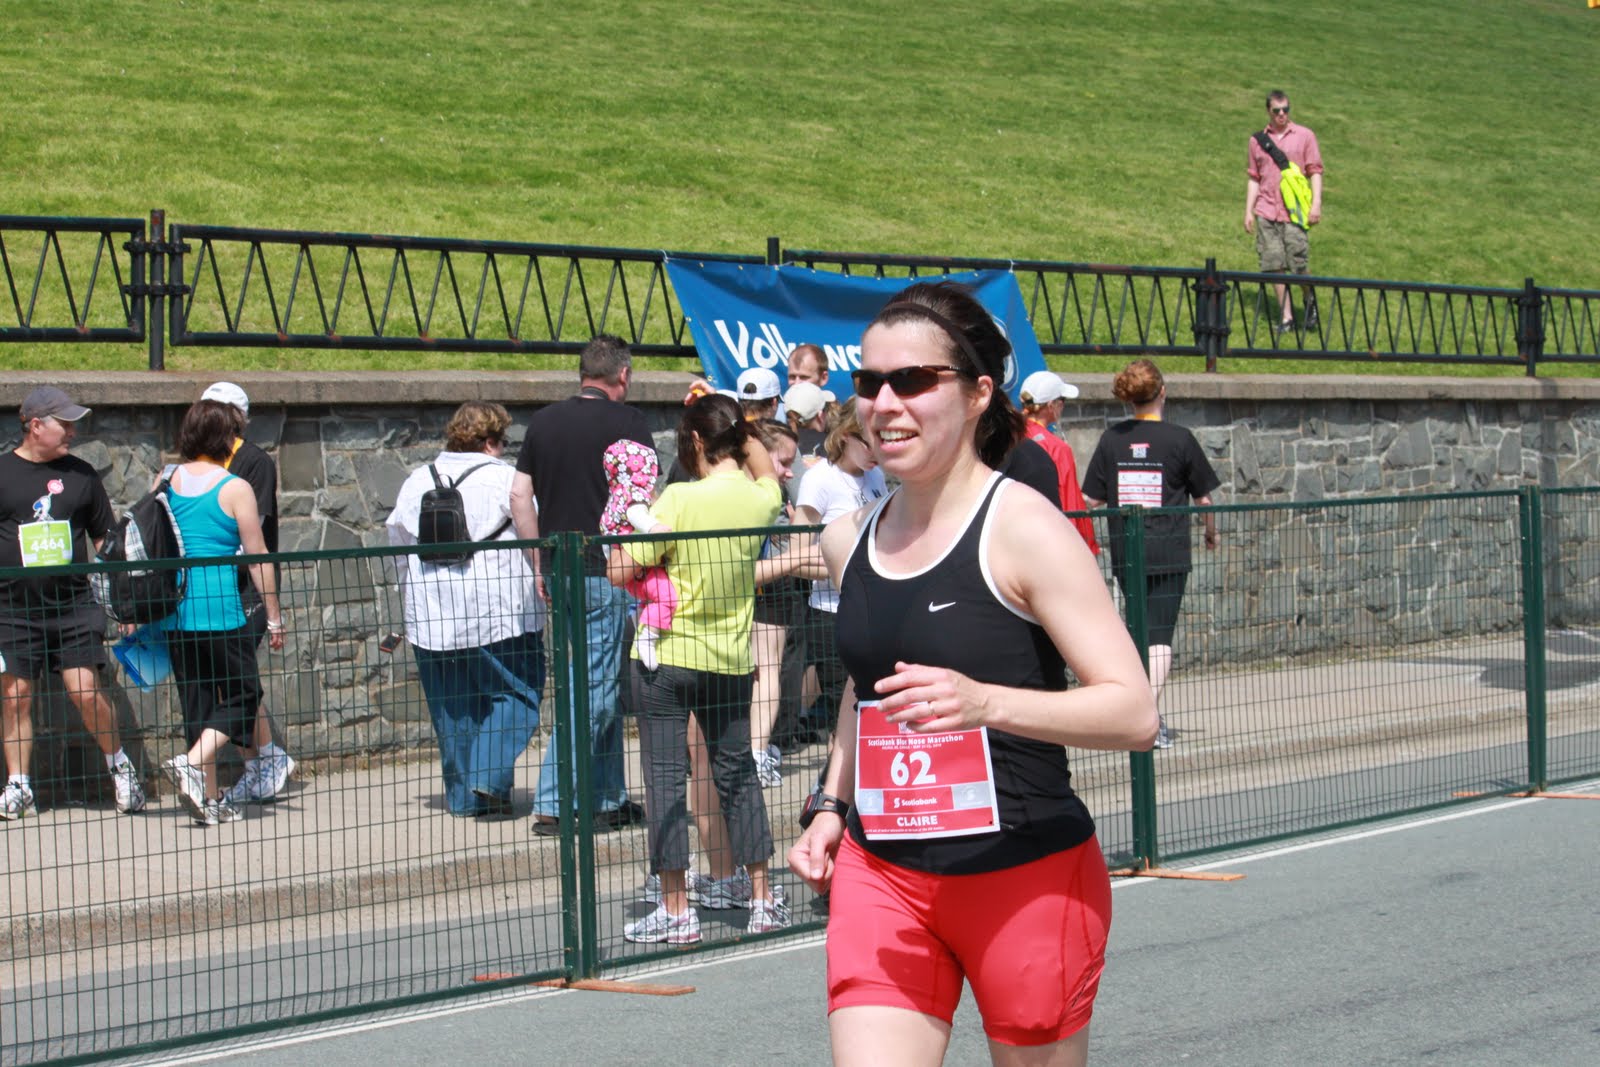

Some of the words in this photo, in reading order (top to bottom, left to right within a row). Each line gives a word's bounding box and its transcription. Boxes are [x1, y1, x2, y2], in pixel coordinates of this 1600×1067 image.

[31, 538, 65, 552] 4464
[868, 738, 896, 747] Scotiabank
[908, 737, 926, 745] Nose
[927, 734, 964, 744] Marathon
[890, 751, 937, 787] 62
[901, 796, 938, 807] Scotiabank
[896, 815, 938, 827] CLAIRE
